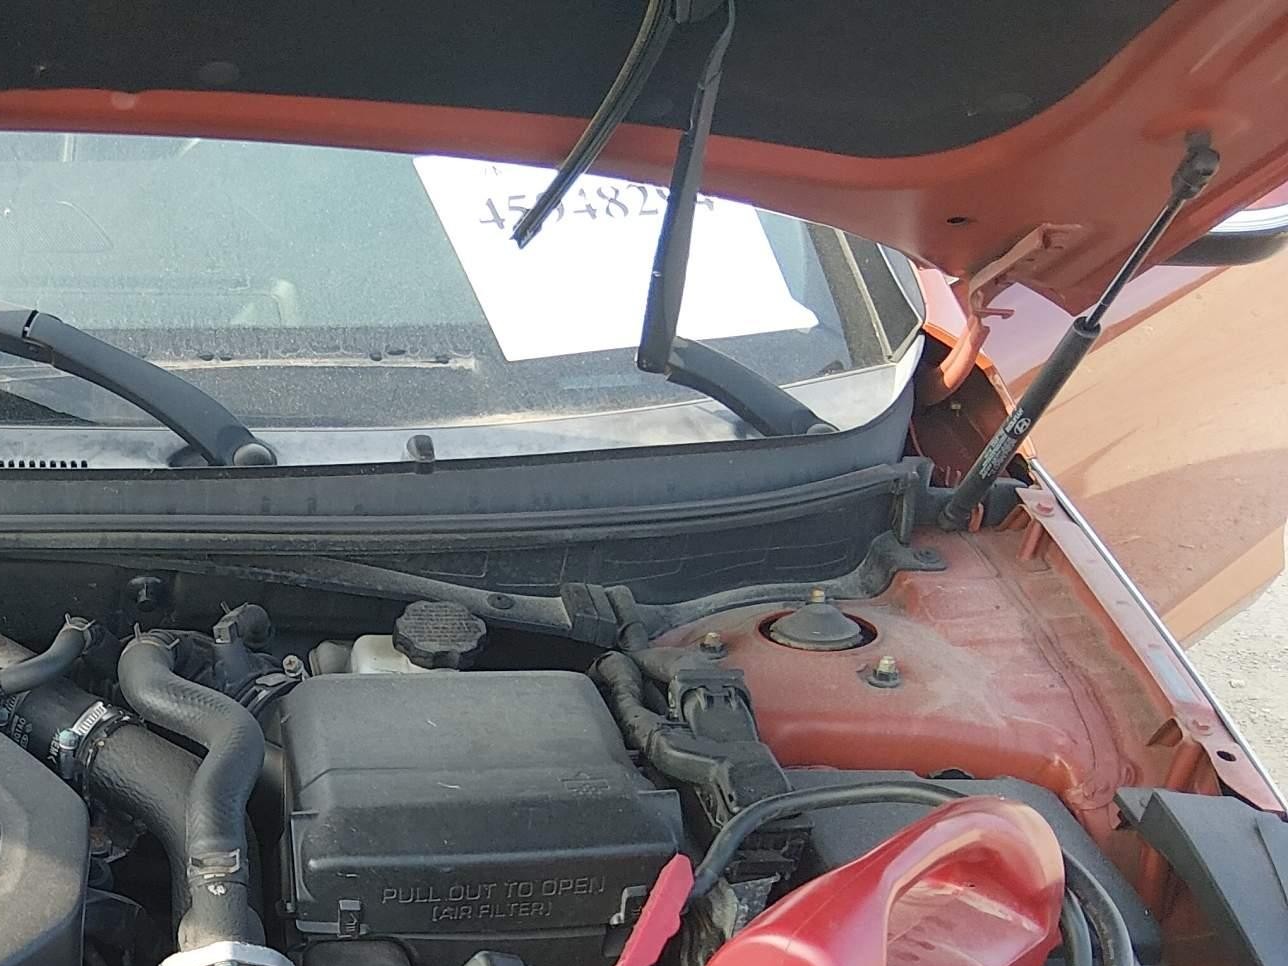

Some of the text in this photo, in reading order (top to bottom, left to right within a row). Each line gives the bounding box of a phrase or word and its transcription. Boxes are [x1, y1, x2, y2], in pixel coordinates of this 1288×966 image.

[381, 876, 606, 905] PULL OUT TO OPEN
